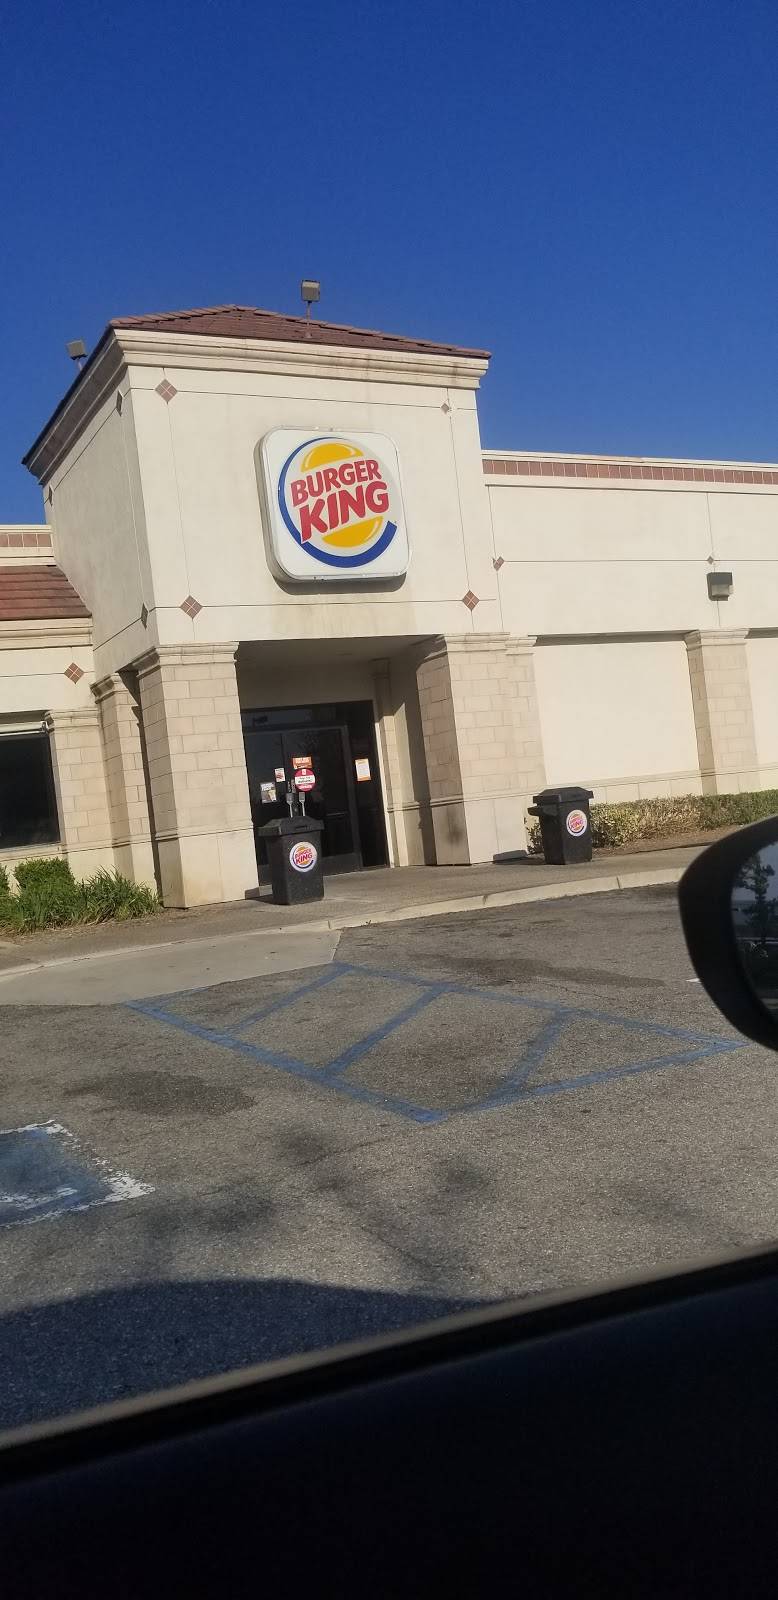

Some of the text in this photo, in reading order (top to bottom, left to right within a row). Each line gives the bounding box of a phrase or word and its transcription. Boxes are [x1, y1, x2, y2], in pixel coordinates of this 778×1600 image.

[290, 459, 382, 507] BURGER
[299, 480, 390, 542] KING
[295, 852, 313, 864] KING
